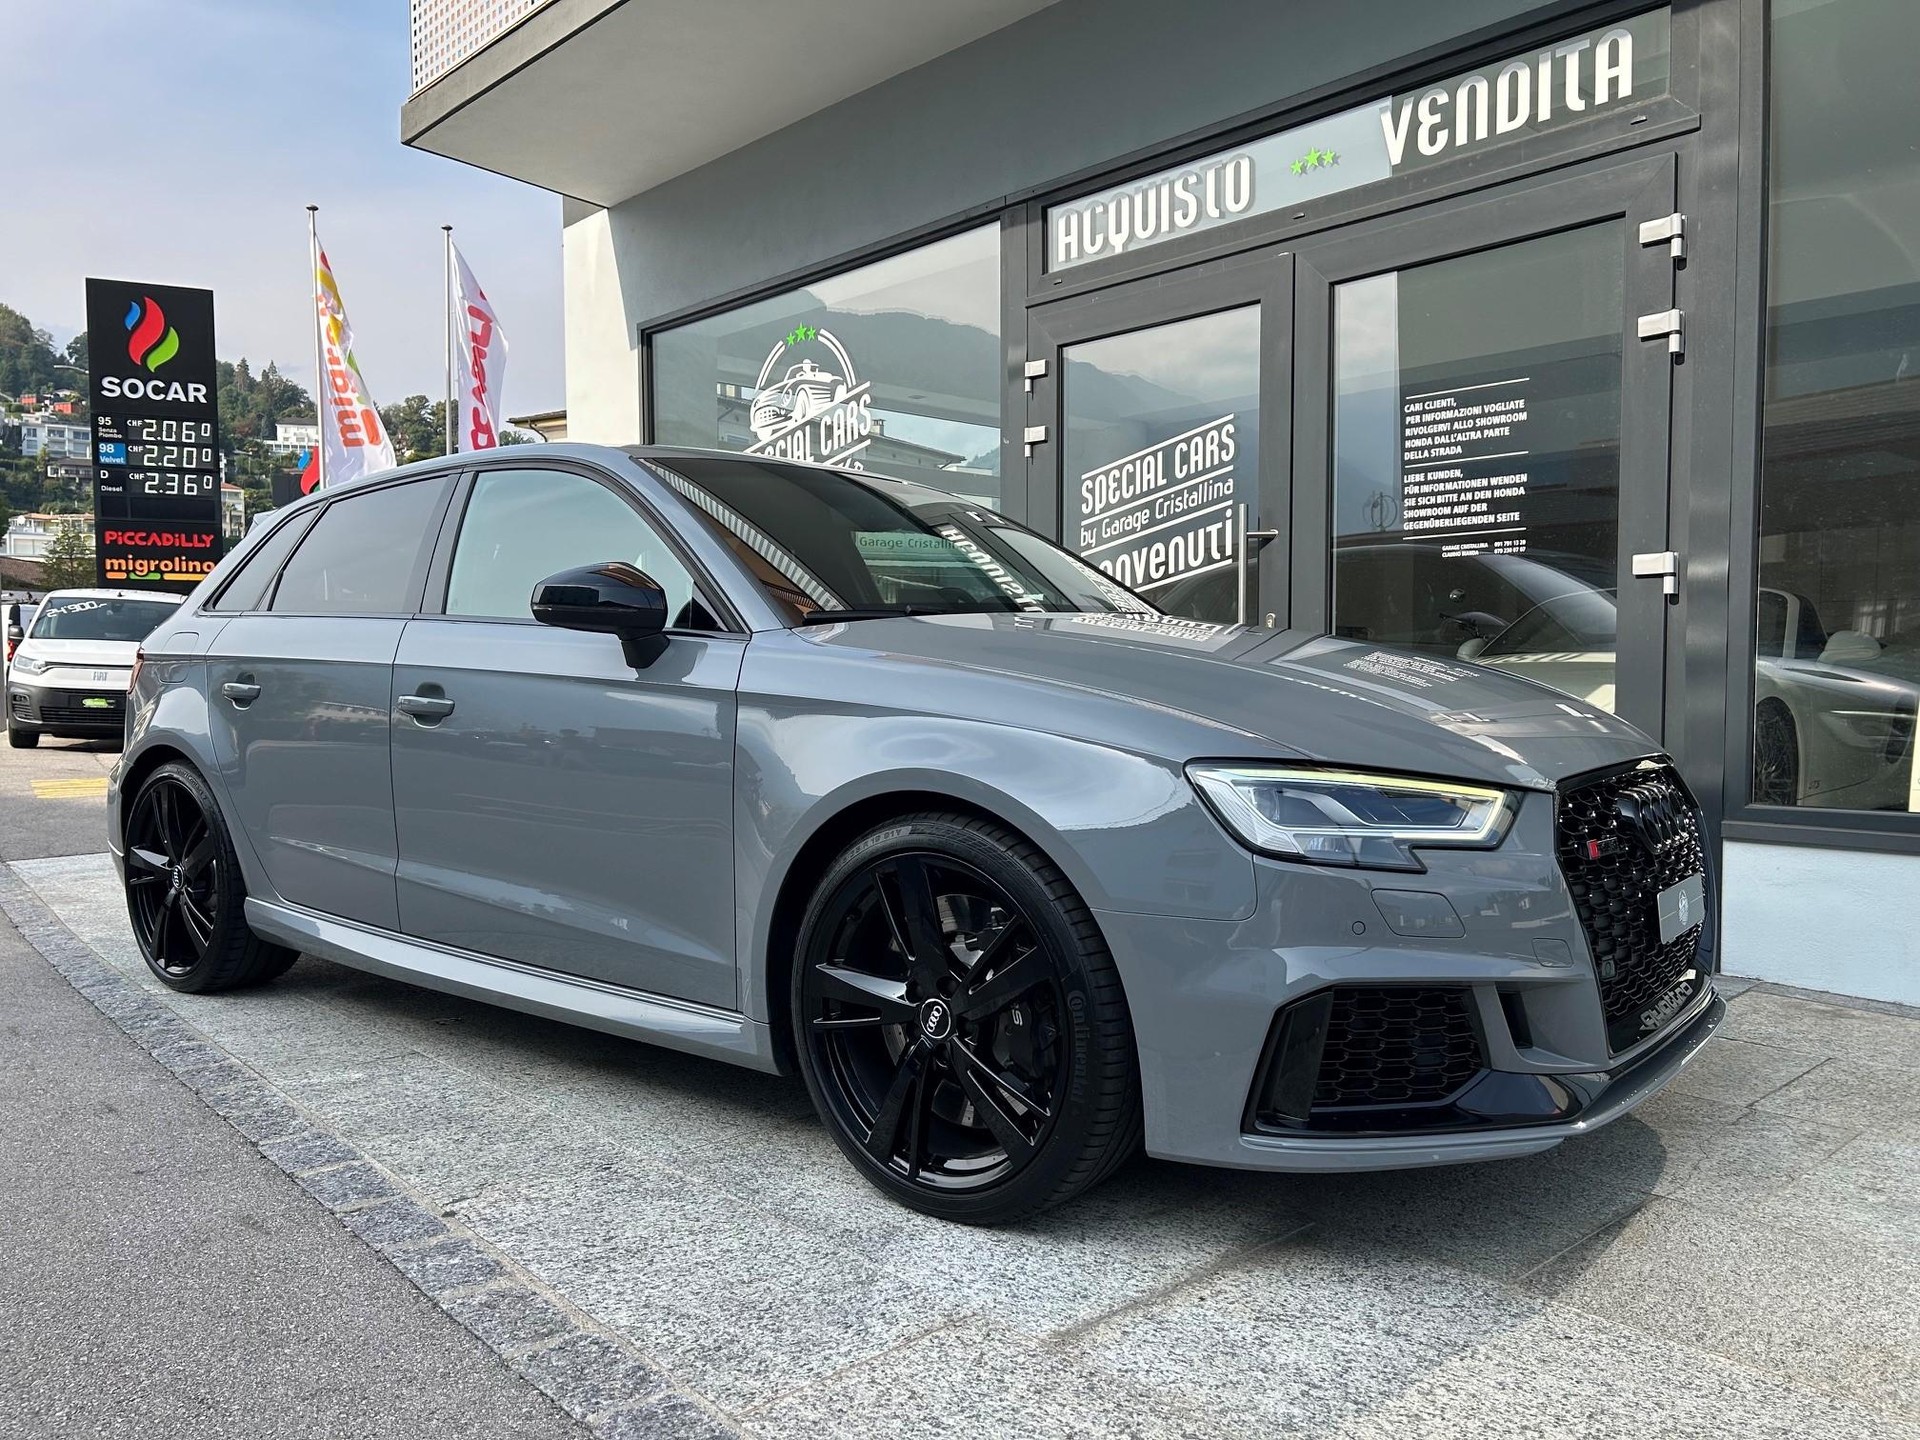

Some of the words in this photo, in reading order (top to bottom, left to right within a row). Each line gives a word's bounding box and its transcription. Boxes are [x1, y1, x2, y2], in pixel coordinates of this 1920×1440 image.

[1056, 154, 1252, 263] ACQUISTO
[1379, 28, 1634, 167] VENDITA
[100, 376, 208, 404] SOCAR
[1404, 402, 1423, 413] CARI
[1424, 397, 1457, 411] CLIENTI,
[1405, 415, 1421, 425] PER
[1422, 405, 1482, 423] INFORMAZIONI
[1483, 399, 1525, 413] VOGLIATE
[97, 416, 112, 425] 95
[126, 419, 143, 427] CHF
[820, 393, 872, 456] CARS
[1405, 422, 1451, 437] RIVOLGERVI
[1453, 419, 1474, 431] ALLO
[1475, 411, 1528, 427] SHOWROOM
[99, 443, 115, 453] 98
[1405, 438, 1433, 449] HONDA
[1434, 430, 1482, 445] DALL'ALTRA
[1483, 426, 1510, 438] PARTE
[99, 455, 124, 465] Velvet
[1404, 450, 1430, 461] DELLA
[1430, 445, 1462, 457] STRADA
[100, 470, 109, 479] D
[1081, 451, 1167, 515] SPECIAL
[1174, 423, 1235, 479] CARS
[1403, 473, 1425, 483] LIEBE
[1427, 469, 1464, 481] KUNDEN,
[1404, 484, 1420, 495] FÜR
[1420, 477, 1488, 493] INFORMATIONEN
[1490, 473, 1528, 486] WENDEN
[1403, 497, 1416, 507] SIE
[1417, 494, 1436, 505] SICH
[1436, 493, 1459, 504] BITTE
[1459, 491, 1473, 502] AN
[1474, 490, 1492, 500] DEN
[1493, 486, 1526, 498] HONDA
[1080, 526, 1097, 548] by
[1102, 508, 1150, 539] Garage
[1155, 478, 1234, 520] Cristallina
[1403, 506, 1452, 519] SHOWROOM
[1452, 504, 1470, 514] AUF
[1470, 503, 1488, 512] DER
[1403, 514, 1495, 530] GEGENÜBERLIEGENDEN
[1496, 512, 1521, 523] SEITE
[860, 536, 903, 550] Garage
[105, 554, 215, 576] migrolino
[93, 671, 109, 681] FIAT
[1640, 981, 1694, 1028] quattro
